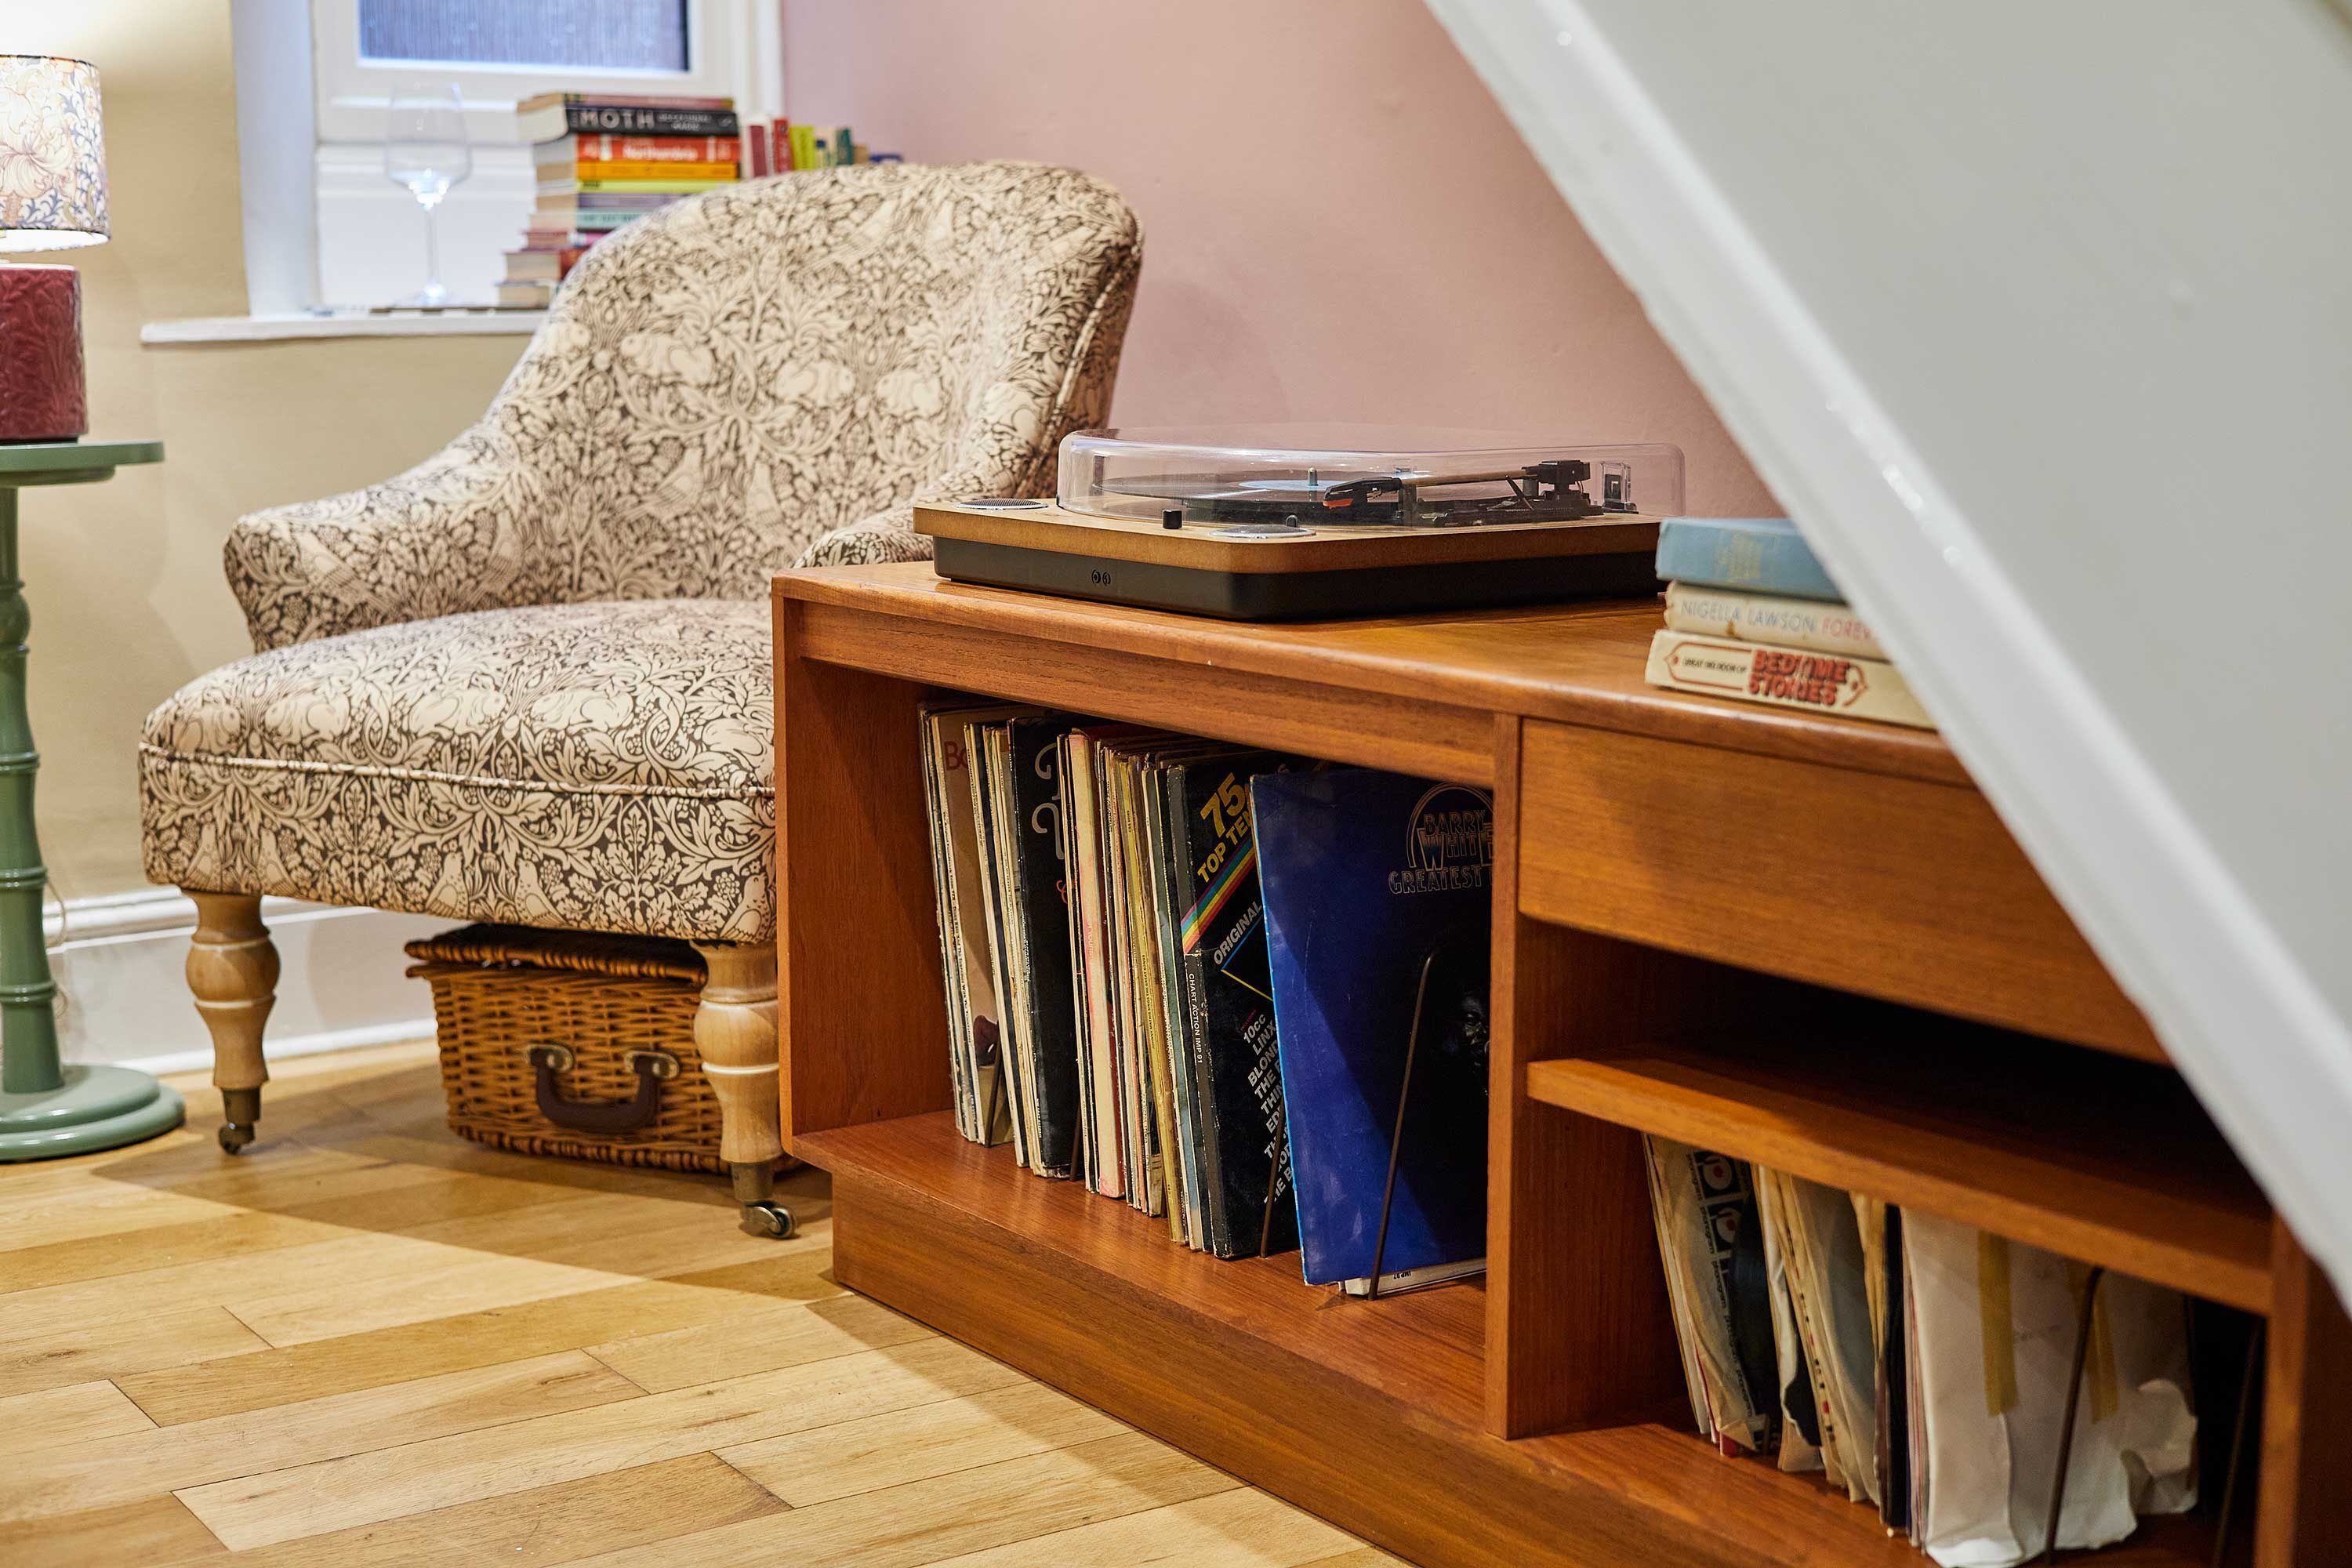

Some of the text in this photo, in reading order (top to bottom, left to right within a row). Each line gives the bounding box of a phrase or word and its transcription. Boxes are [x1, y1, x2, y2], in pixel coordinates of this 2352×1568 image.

[580, 108, 655, 129] MOTH
[1682, 601, 1741, 623] NIGELLA
[1747, 608, 1816, 633] LAWSON
[1753, 649, 1851, 685] BEDTIME
[1748, 672, 1838, 706] STORIES
[1200, 771, 1248, 838] 75
[1424, 809, 1486, 835] BARRY
[1196, 841, 1227, 884] TOP
[1388, 864, 1482, 895] GREATEST
[1214, 902, 1263, 966] ORIGINAL
[1189, 973, 1197, 1003] CHART
[1192, 1003, 1201, 1036] ACTION
[1243, 1014, 1265, 1044] 10cc
[1252, 1020, 1276, 1056] LINX
[1254, 1069, 1276, 1099] THE
